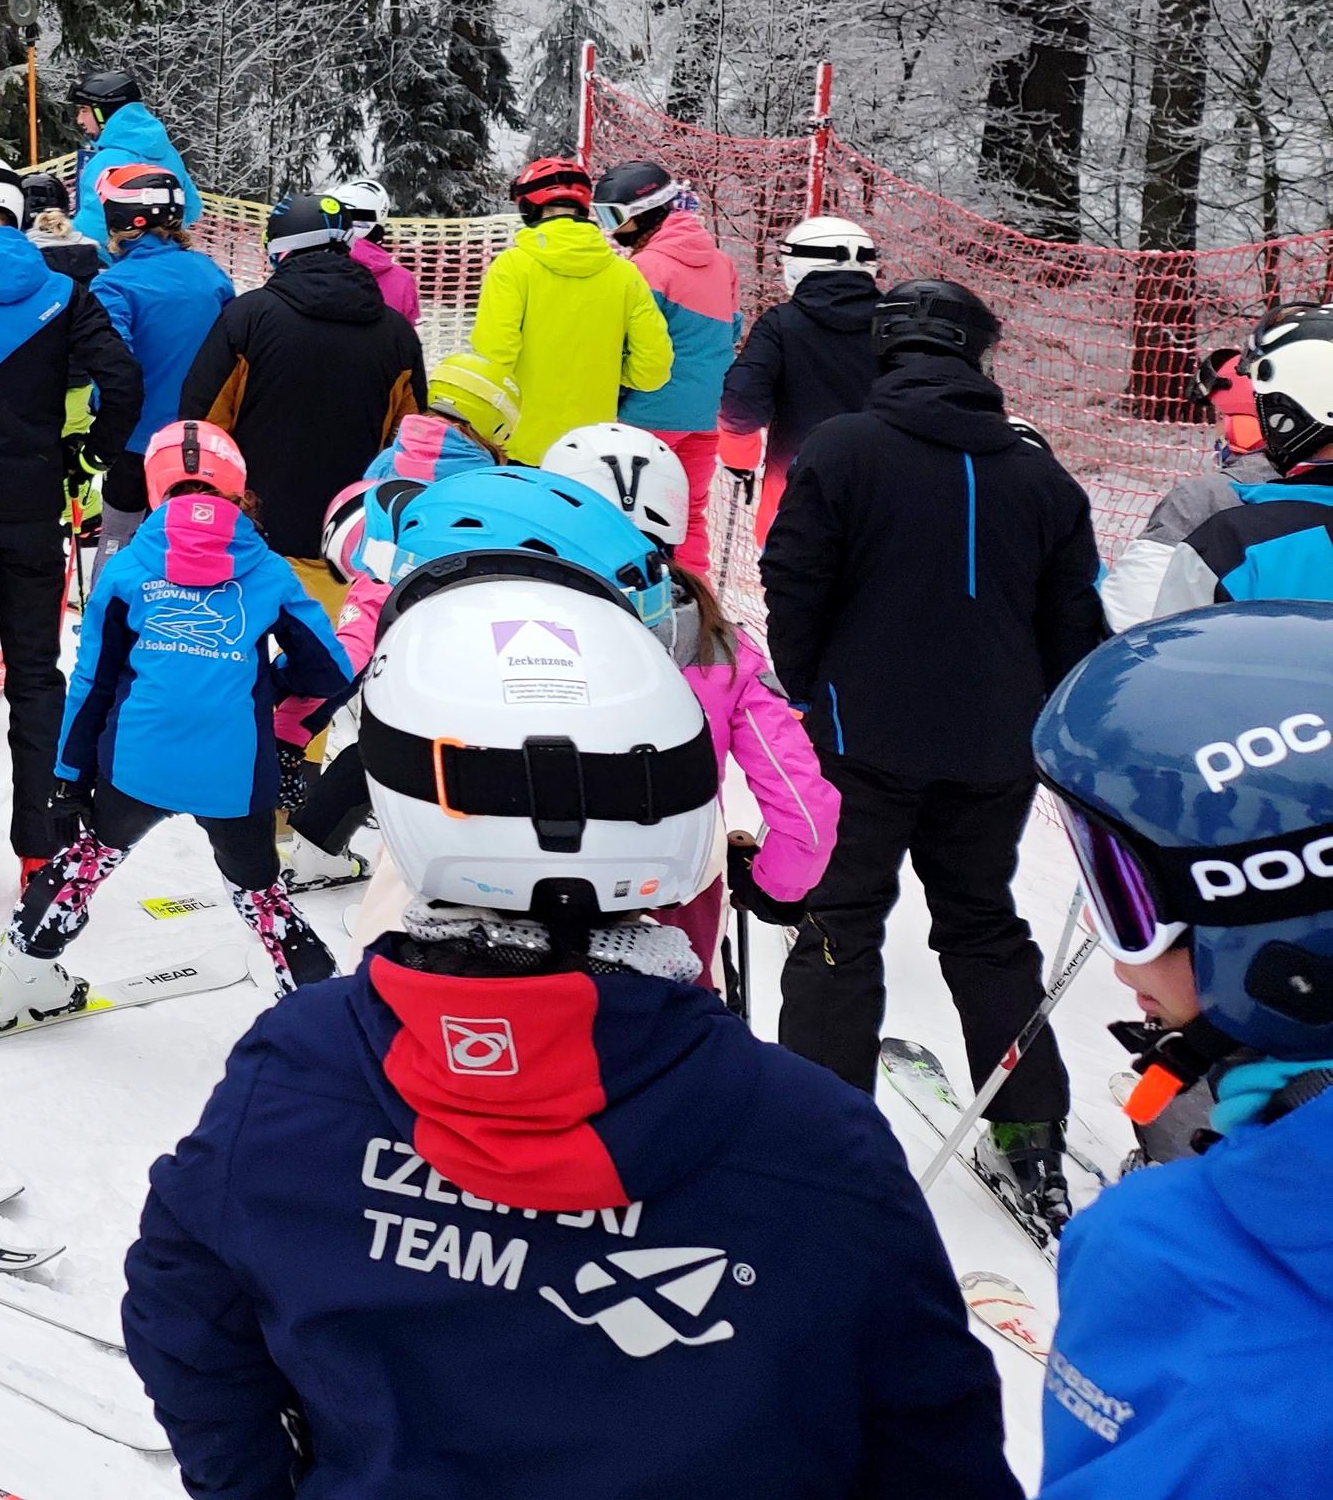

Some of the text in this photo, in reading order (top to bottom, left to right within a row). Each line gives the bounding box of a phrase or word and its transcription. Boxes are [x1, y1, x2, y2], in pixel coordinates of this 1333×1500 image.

[145, 639, 177, 652] Sokol
[179, 642, 220, 659] Deštné
[221, 652, 229, 660] v
[507, 655, 574, 668] Zeckenzone
[1195, 713, 1332, 793] poc
[145, 967, 198, 984] HEAD
[364, 1208, 529, 1291] TEAM
